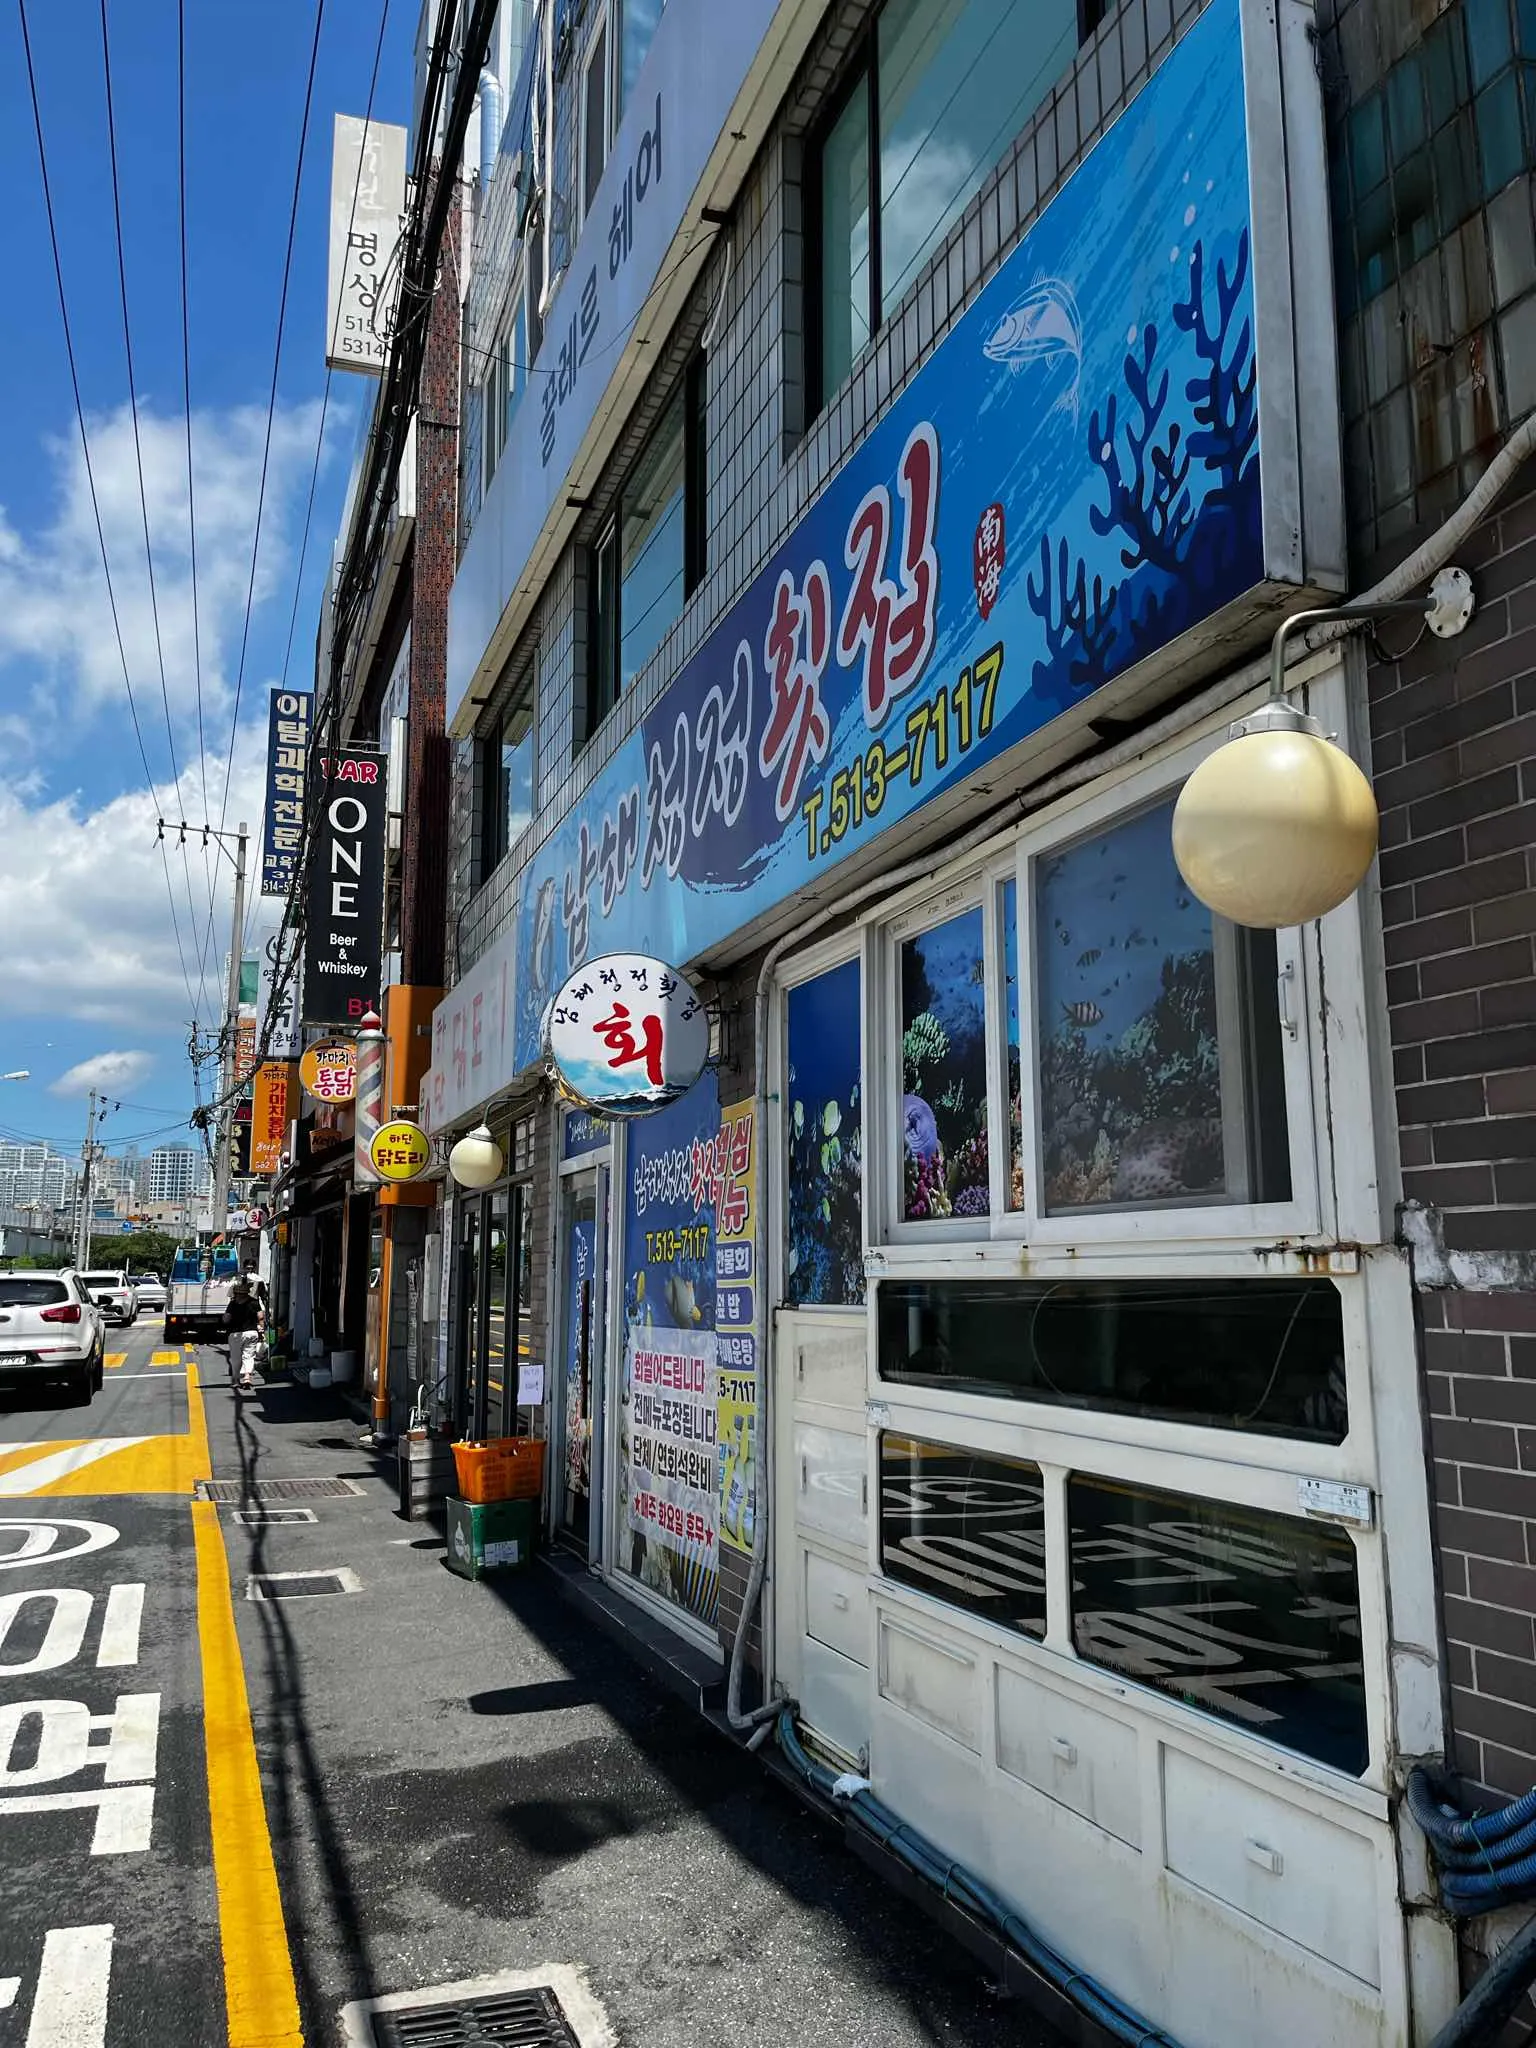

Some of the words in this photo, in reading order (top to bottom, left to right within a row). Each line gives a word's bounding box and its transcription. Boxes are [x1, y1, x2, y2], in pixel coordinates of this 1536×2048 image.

[609, 91, 662, 280] 헤어
[348, 231, 380, 309] 명상
[342, 337, 384, 358] 5314
[976, 507, 1002, 606] 南海
[320, 757, 378, 783] BAR
[327, 796, 368, 918] ONE
[329, 933, 358, 947] Beer
[338, 948, 348, 960] &
[318, 960, 368, 978] Whiskey
[553, 967, 704, 1026] 남해청정횟집
[316, 1052, 349, 1065] 가마치
[592, 1001, 664, 1086] 회
[314, 1067, 357, 1097] 통닭
[389, 1134, 413, 1145] 하단
[377, 1149, 424, 1167] 닭도리
[646, 1226, 710, 1264] T.513-7117
[658, 1500, 683, 1537] 화요일
[686, 1511, 705, 1545] 휴무
